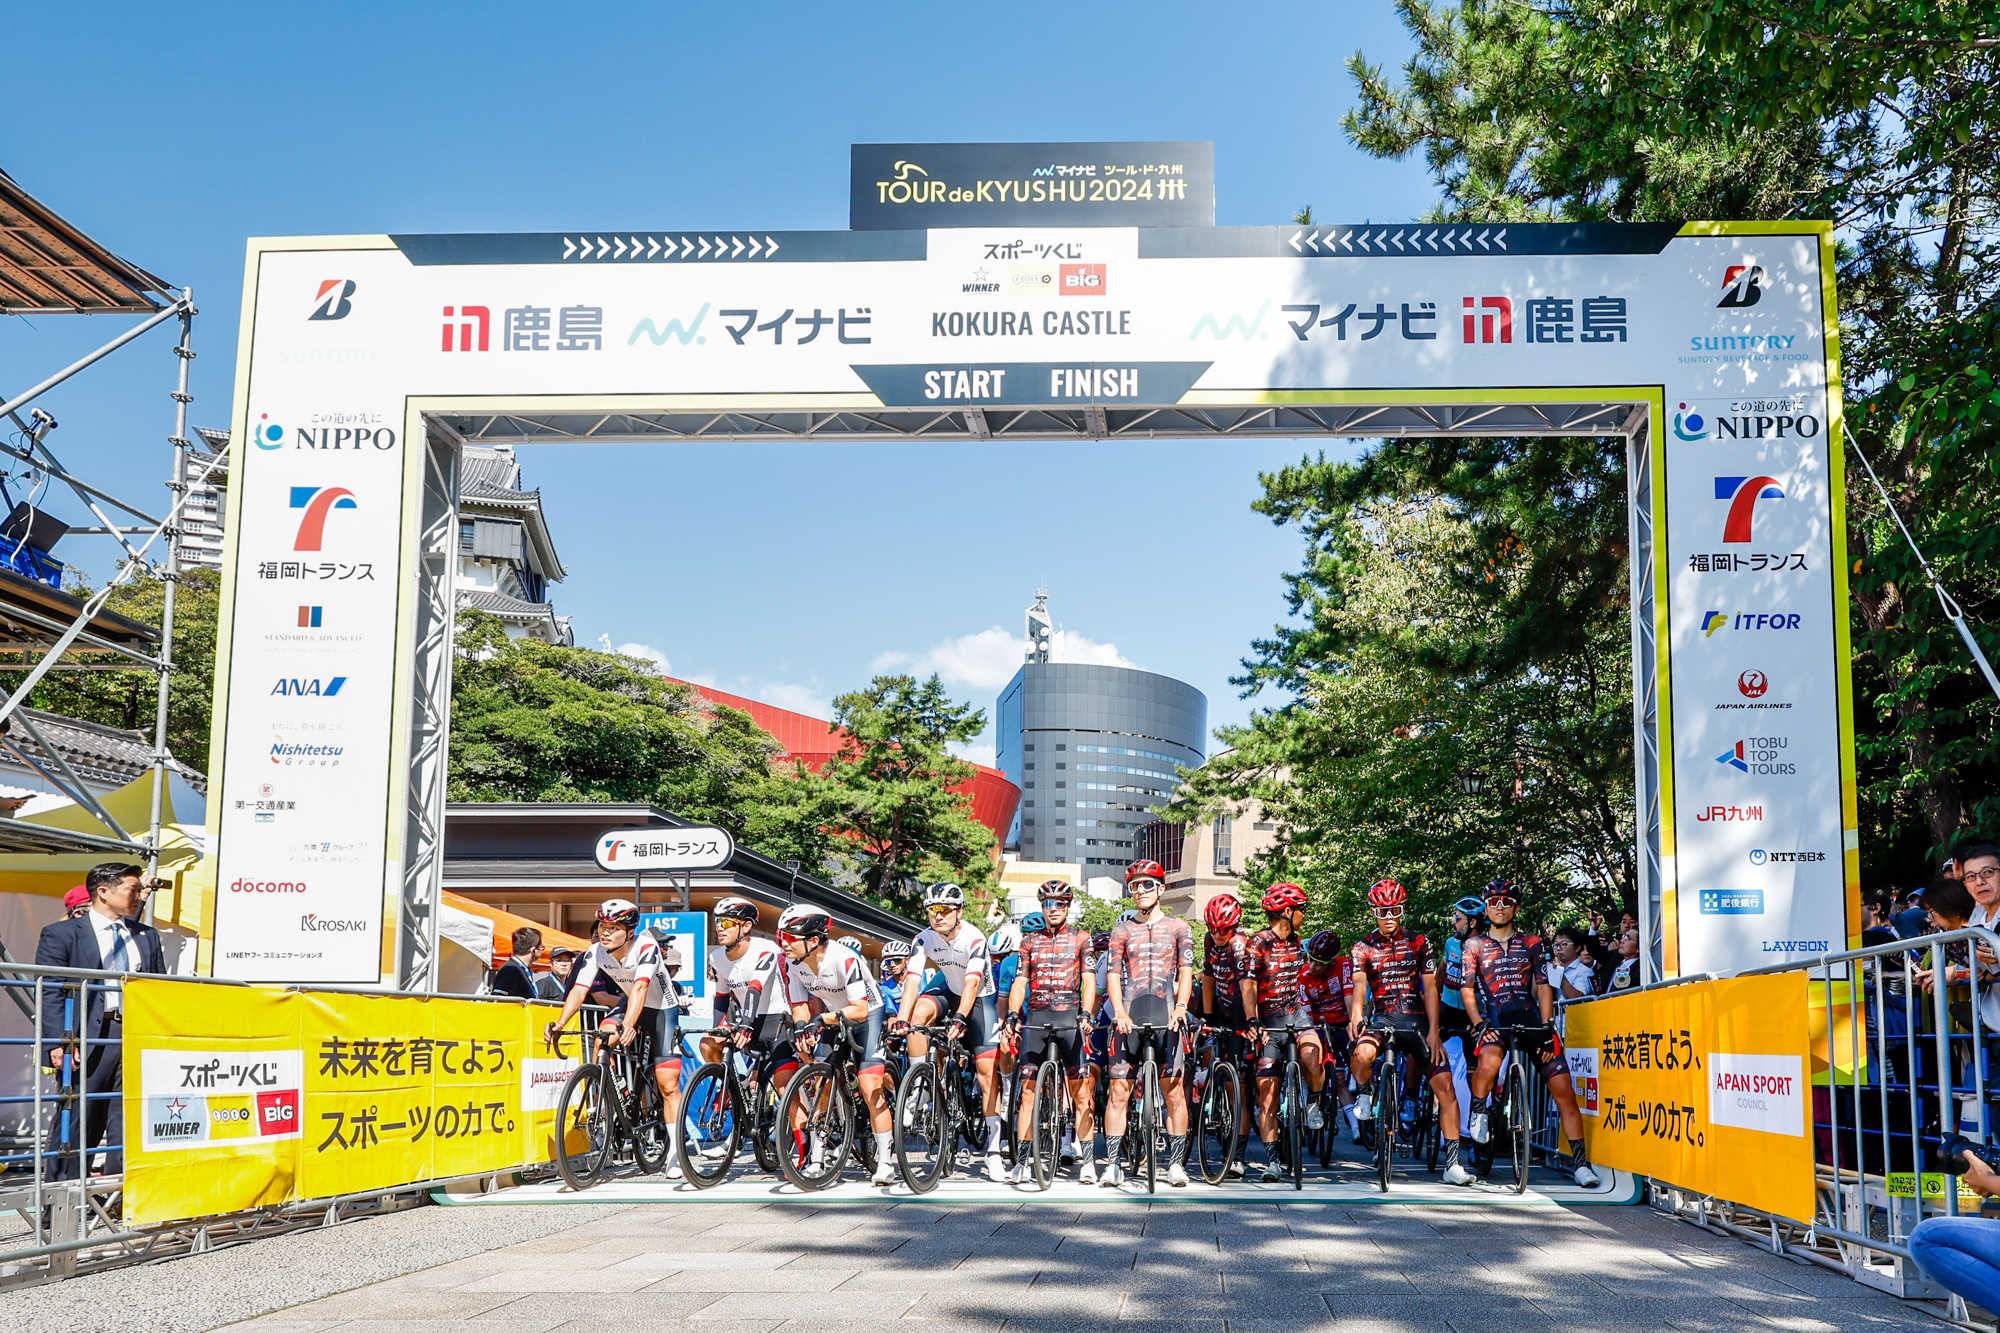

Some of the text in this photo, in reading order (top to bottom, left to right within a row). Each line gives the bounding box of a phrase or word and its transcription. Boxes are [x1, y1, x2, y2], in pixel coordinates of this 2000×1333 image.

[1056, 164, 1183, 176] マイナビ ツール・ド・九州
[984, 240, 1082, 260] スポーツくじ
[1012, 274, 1051, 284] toto
[1065, 272, 1101, 288] BIG
[962, 283, 1000, 292] WINNER
[719, 308, 872, 346] マイナビ
[932, 310, 1131, 336] KOKURA CASTLE
[1281, 302, 1436, 342] マイナビ
[1525, 295, 1628, 343] 鹿島
[503, 304, 603, 352] 鹿島
[1678, 355, 1721, 364] SUNTORY
[1724, 354, 1770, 362] BEVERAGE
[924, 368, 1138, 398] START FINISH
[1730, 400, 1804, 412] この道の先に
[310, 412, 382, 424] この道の先に
[1716, 414, 1820, 440] NIPPO
[295, 428, 396, 450] NIPPO
[1689, 553, 1808, 572] 福岡トランス
[257, 561, 375, 581] 福岡トランス
[270, 678, 321, 696] ANA
[270, 743, 344, 756] Nishitetsu
[1749, 737, 1788, 748] TOBU
[285, 757, 339, 768] Group
[1750, 750, 1778, 762] TOP
[1750, 764, 1796, 775] TOURS
[234, 800, 296, 810] 第一交通産業
[1696, 806, 1763, 822] JR九州
[632, 841, 719, 858] 福岡トランス
[1770, 852, 1826, 862] NTT西日本
[230, 878, 307, 893] docomo
[1720, 899, 1760, 908] 肥後銀行
[301, 914, 366, 932] KROSAKI
[645, 918, 678, 930] LAST
[1762, 941, 1829, 952] LAWSON
[318, 1035, 514, 1079] 未来を育てよう、
[1603, 1028, 1702, 1070] 未来を育てよう、
[1570, 1052, 1592, 1074] スポーツくじ
[180, 1058, 278, 1088] スポーツくじ
[530, 1072, 554, 1088] JAPAN
[1714, 1072, 1792, 1096] APAN SPORT
[1587, 1088, 1596, 1101] BIG
[1737, 1098, 1768, 1111] COUNCIL
[212, 1108, 250, 1122] toto
[264, 1104, 294, 1123] BIG
[1603, 1094, 1704, 1148] スポーツの力で。
[154, 1121, 200, 1137] WINNER
[317, 1105, 516, 1153] スポーツの力で。
